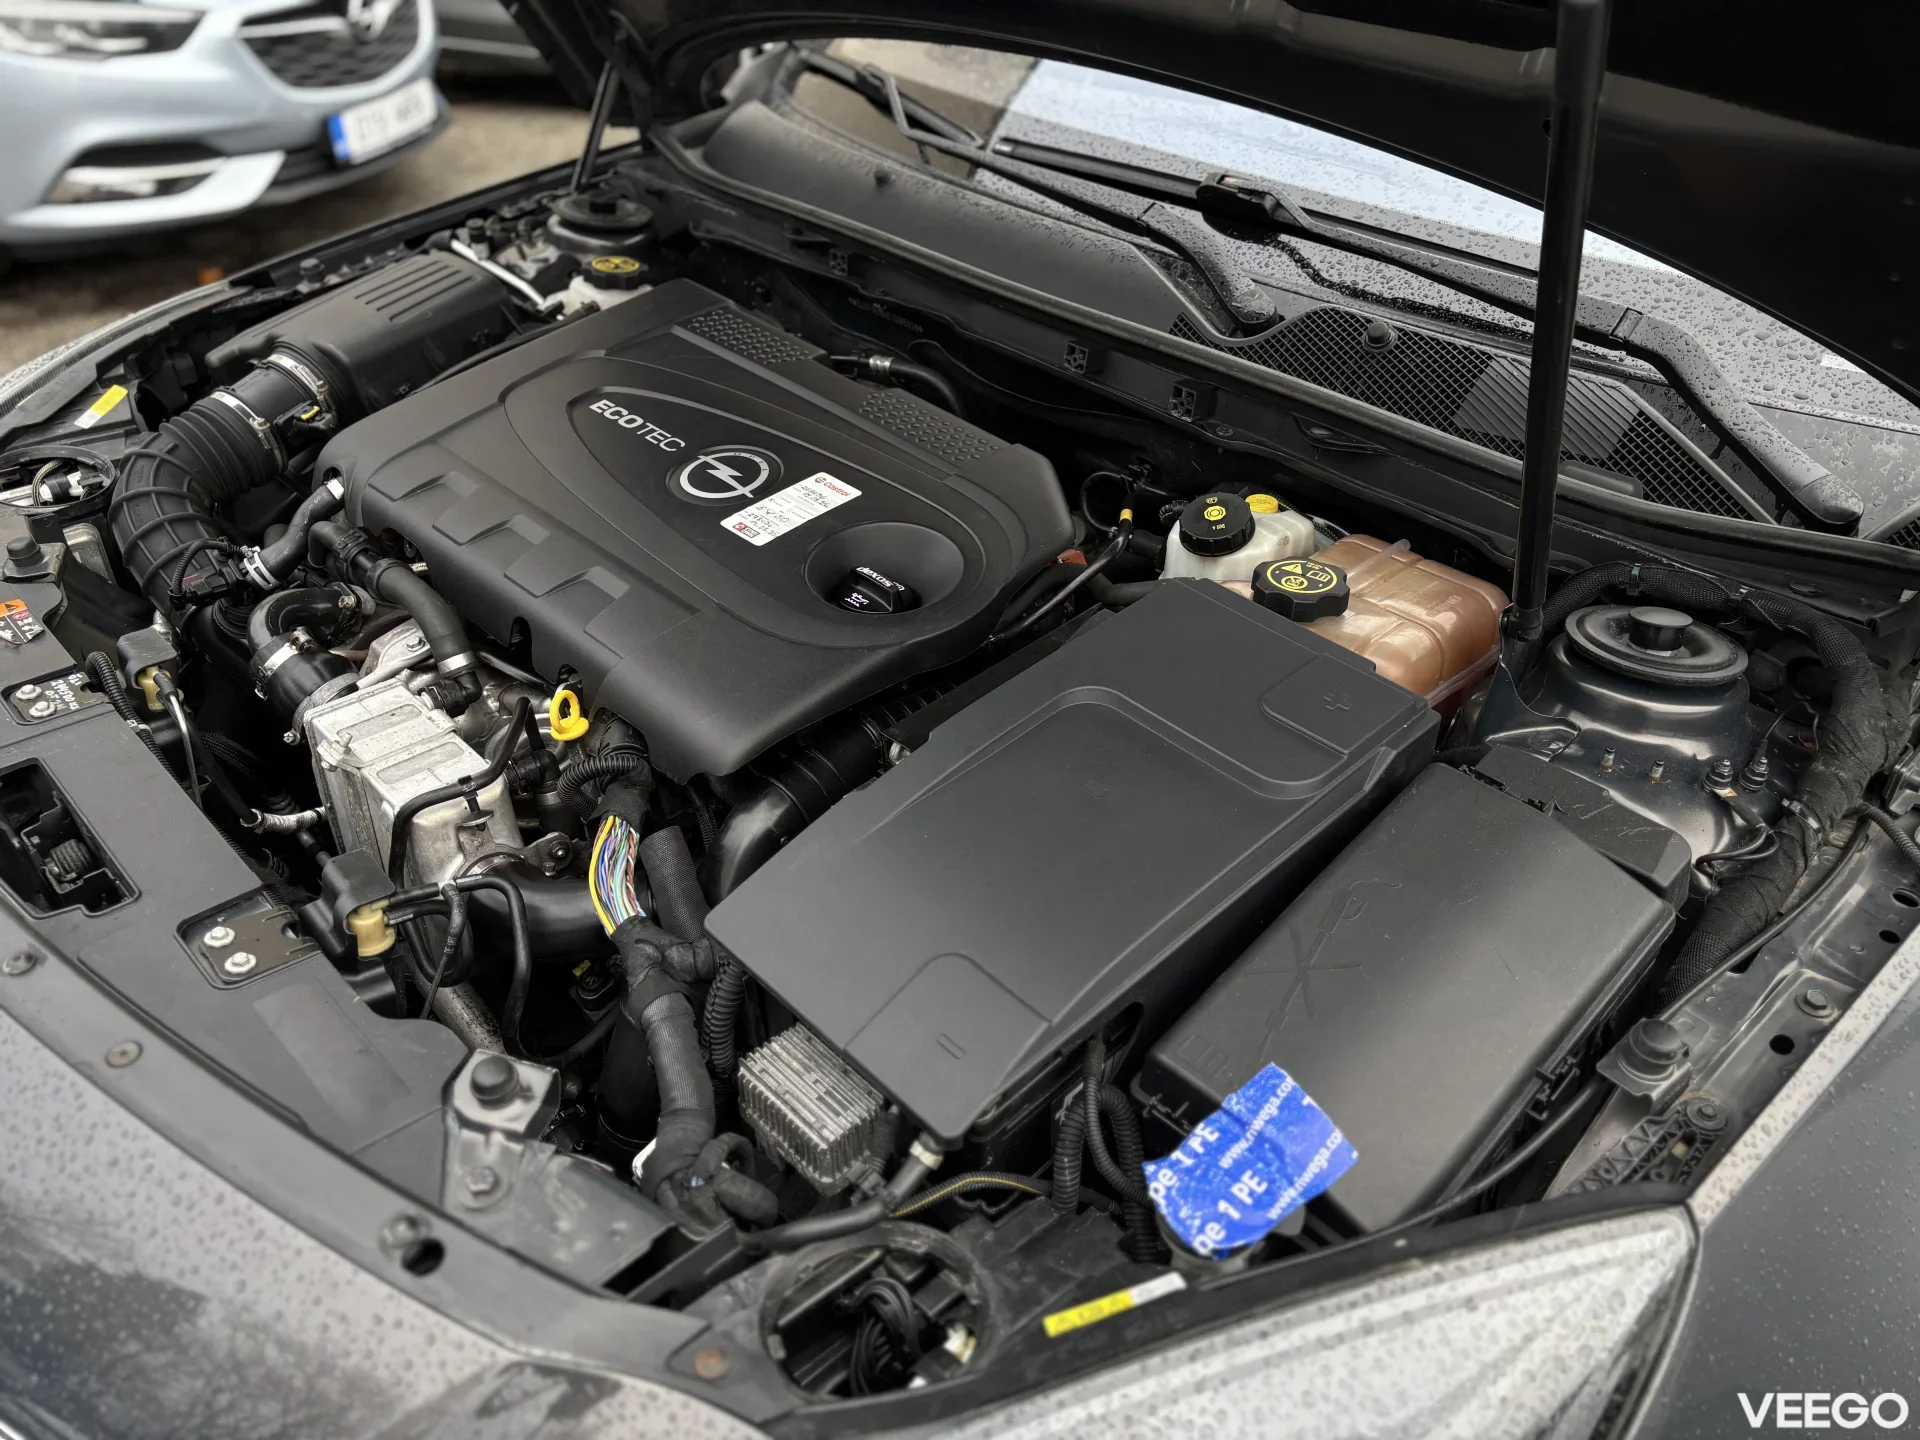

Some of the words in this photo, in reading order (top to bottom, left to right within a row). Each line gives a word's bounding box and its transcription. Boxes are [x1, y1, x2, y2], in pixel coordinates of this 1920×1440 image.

[589, 399, 686, 452] ECOTEC
[823, 480, 851, 497] Castrol
[1188, 1122, 1220, 1154] PE
[1217, 1199, 1242, 1220] 1
[1231, 1169, 1269, 1206] PE
